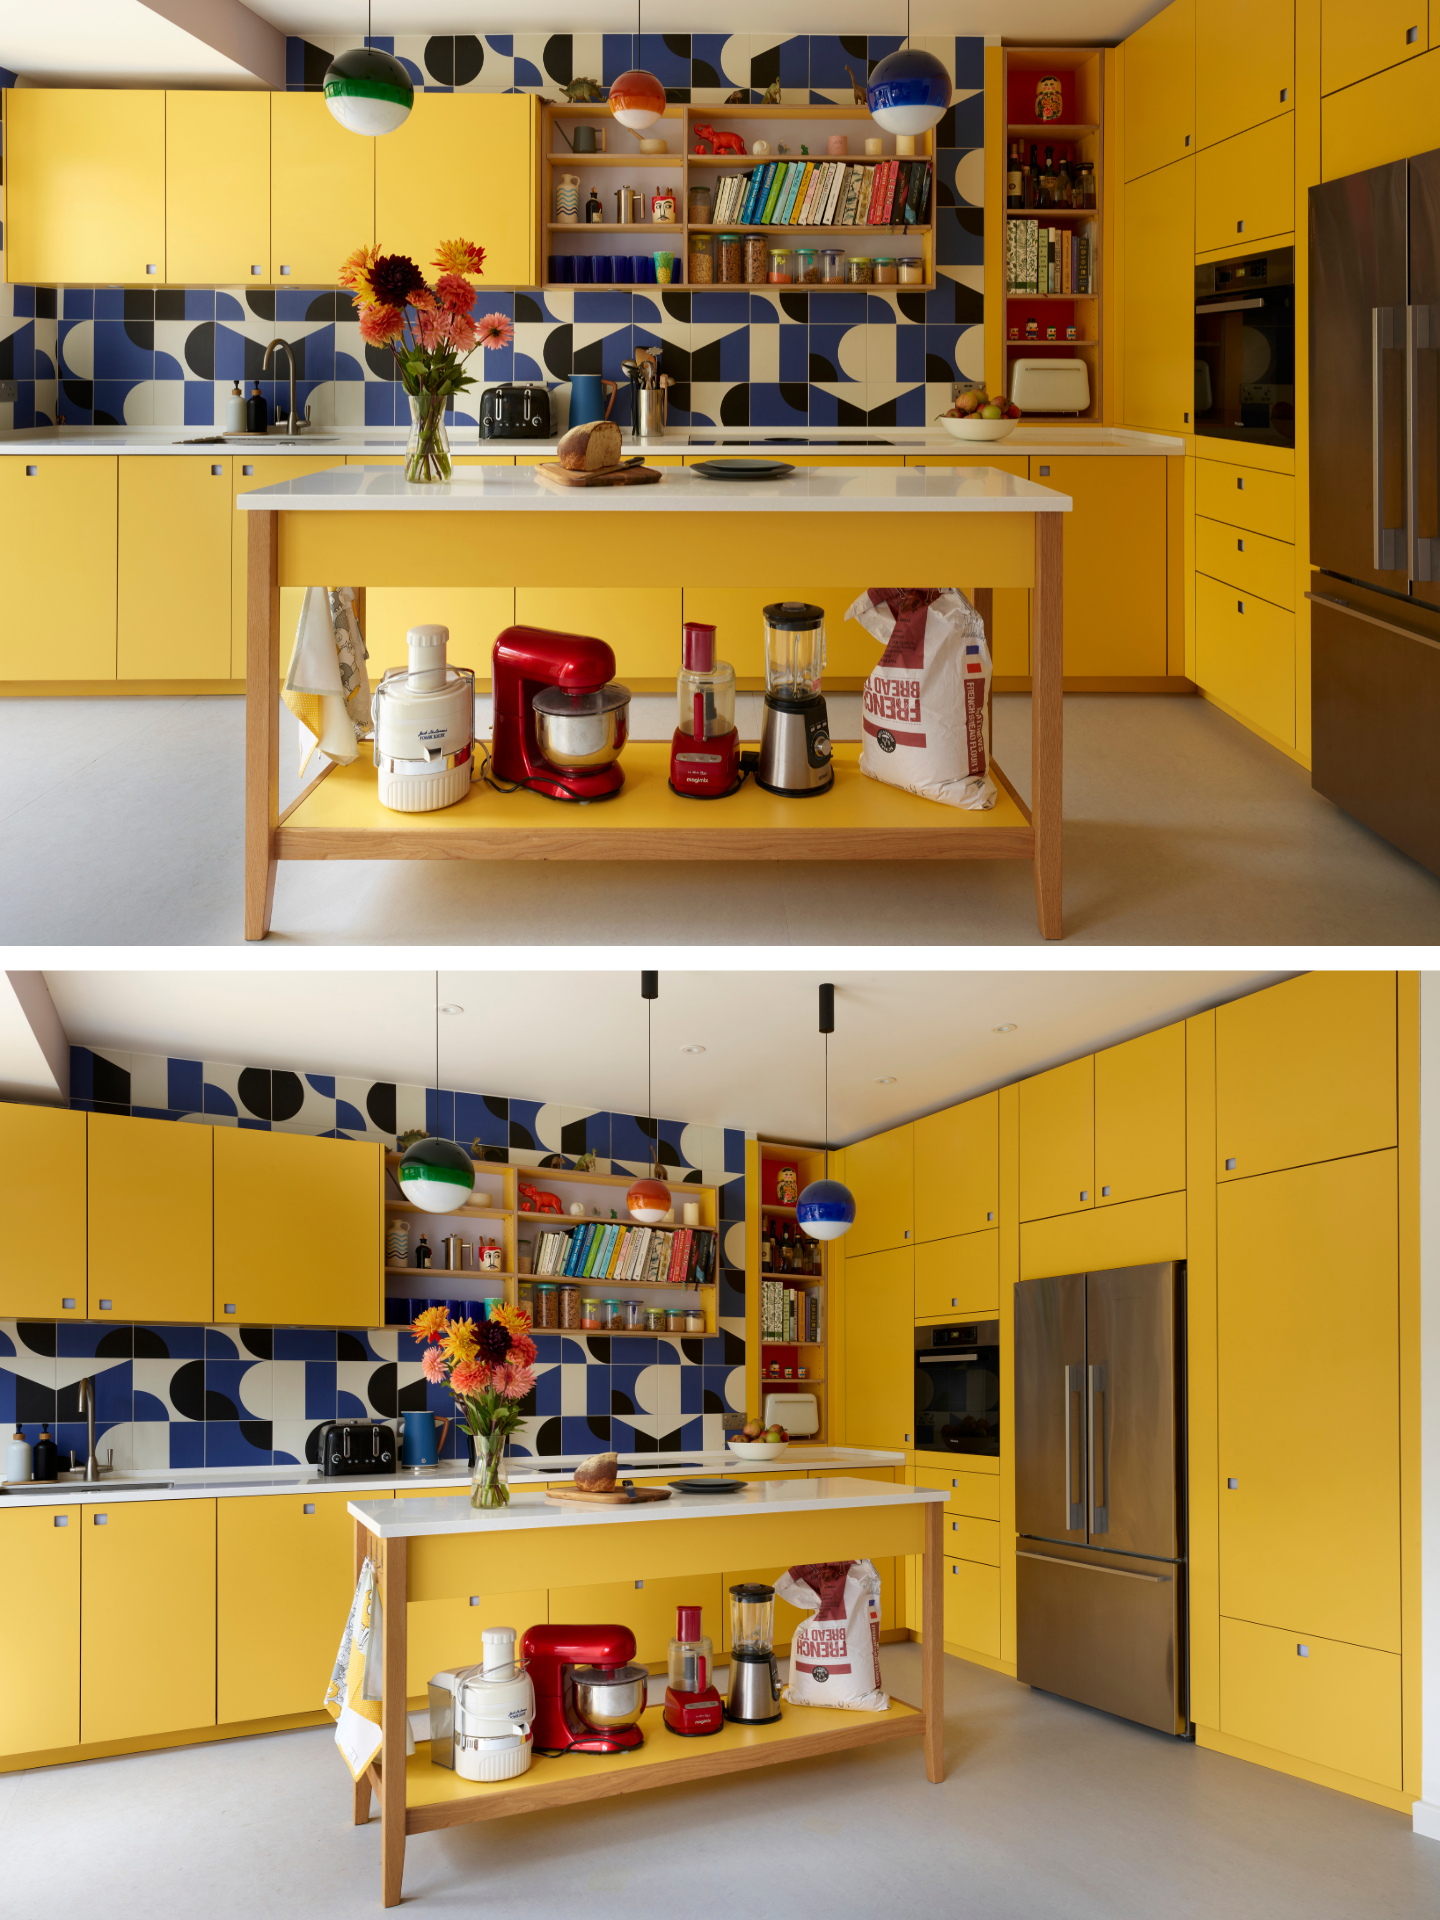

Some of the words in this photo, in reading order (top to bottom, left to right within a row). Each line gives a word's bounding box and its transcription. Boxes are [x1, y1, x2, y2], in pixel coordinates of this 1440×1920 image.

[884, 178, 896, 205] LEON
[874, 677, 920, 698] BREAD
[966, 682, 976, 714] FRENCH
[968, 714, 976, 741] BREAD
[969, 741, 978, 767] FLOUR
[812, 1628, 845, 1641] BREAD
[797, 1641, 847, 1657] FRENCH
